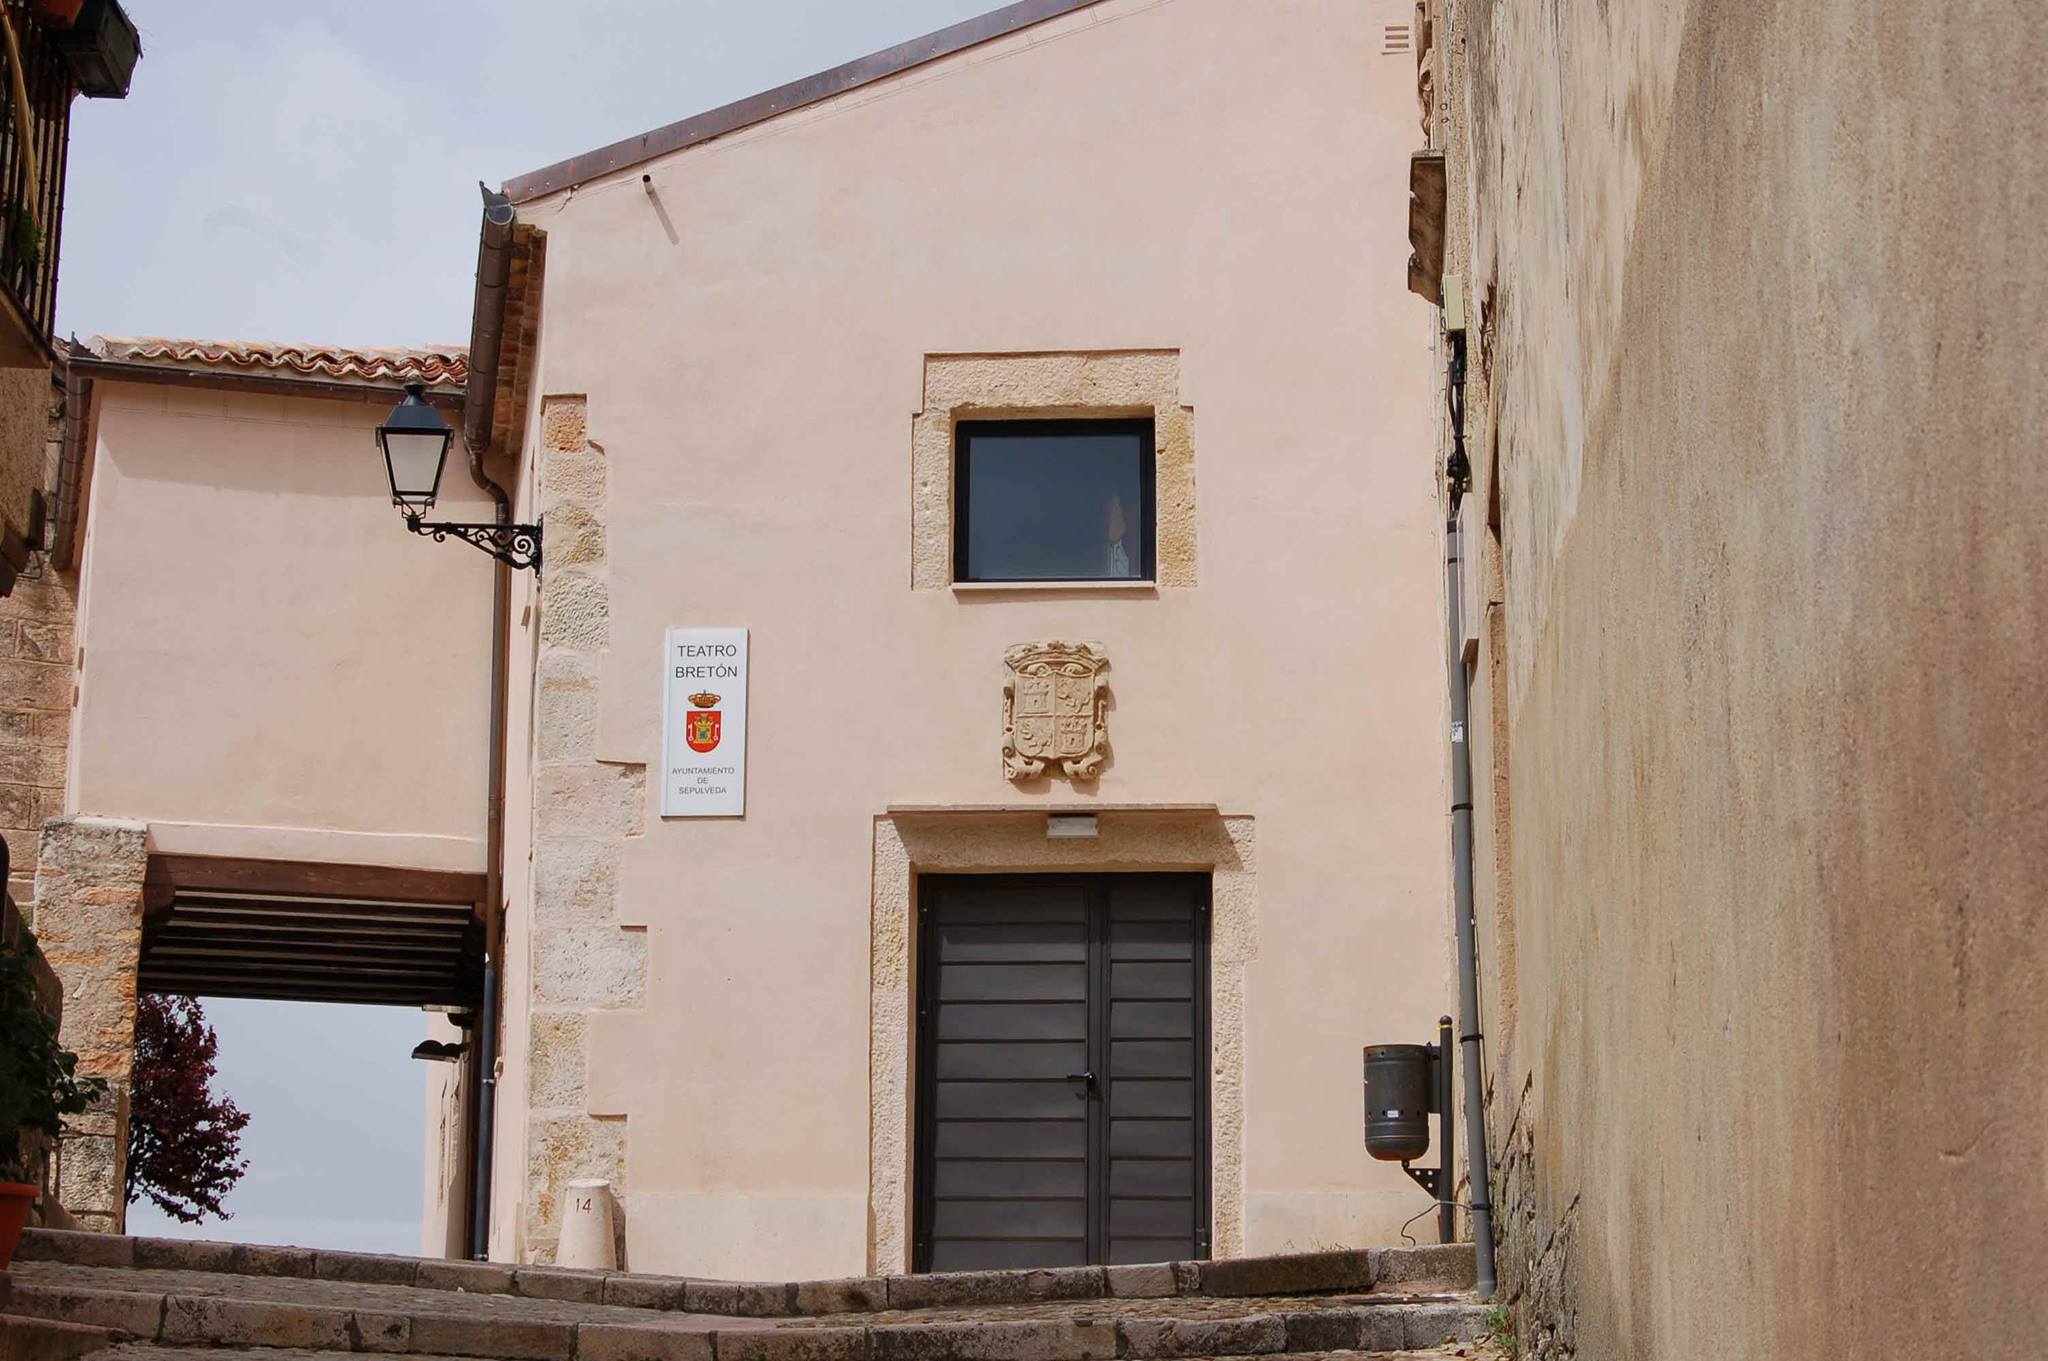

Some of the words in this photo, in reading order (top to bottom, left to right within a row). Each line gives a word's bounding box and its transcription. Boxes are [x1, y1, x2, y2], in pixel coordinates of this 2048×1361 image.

[677, 644, 737, 657] TEATRO
[675, 664, 738, 678] BRETÓN
[672, 767, 735, 775] AYUNTAMIENTO
[697, 777, 709, 785] DE
[576, 1198, 592, 1213] 14
